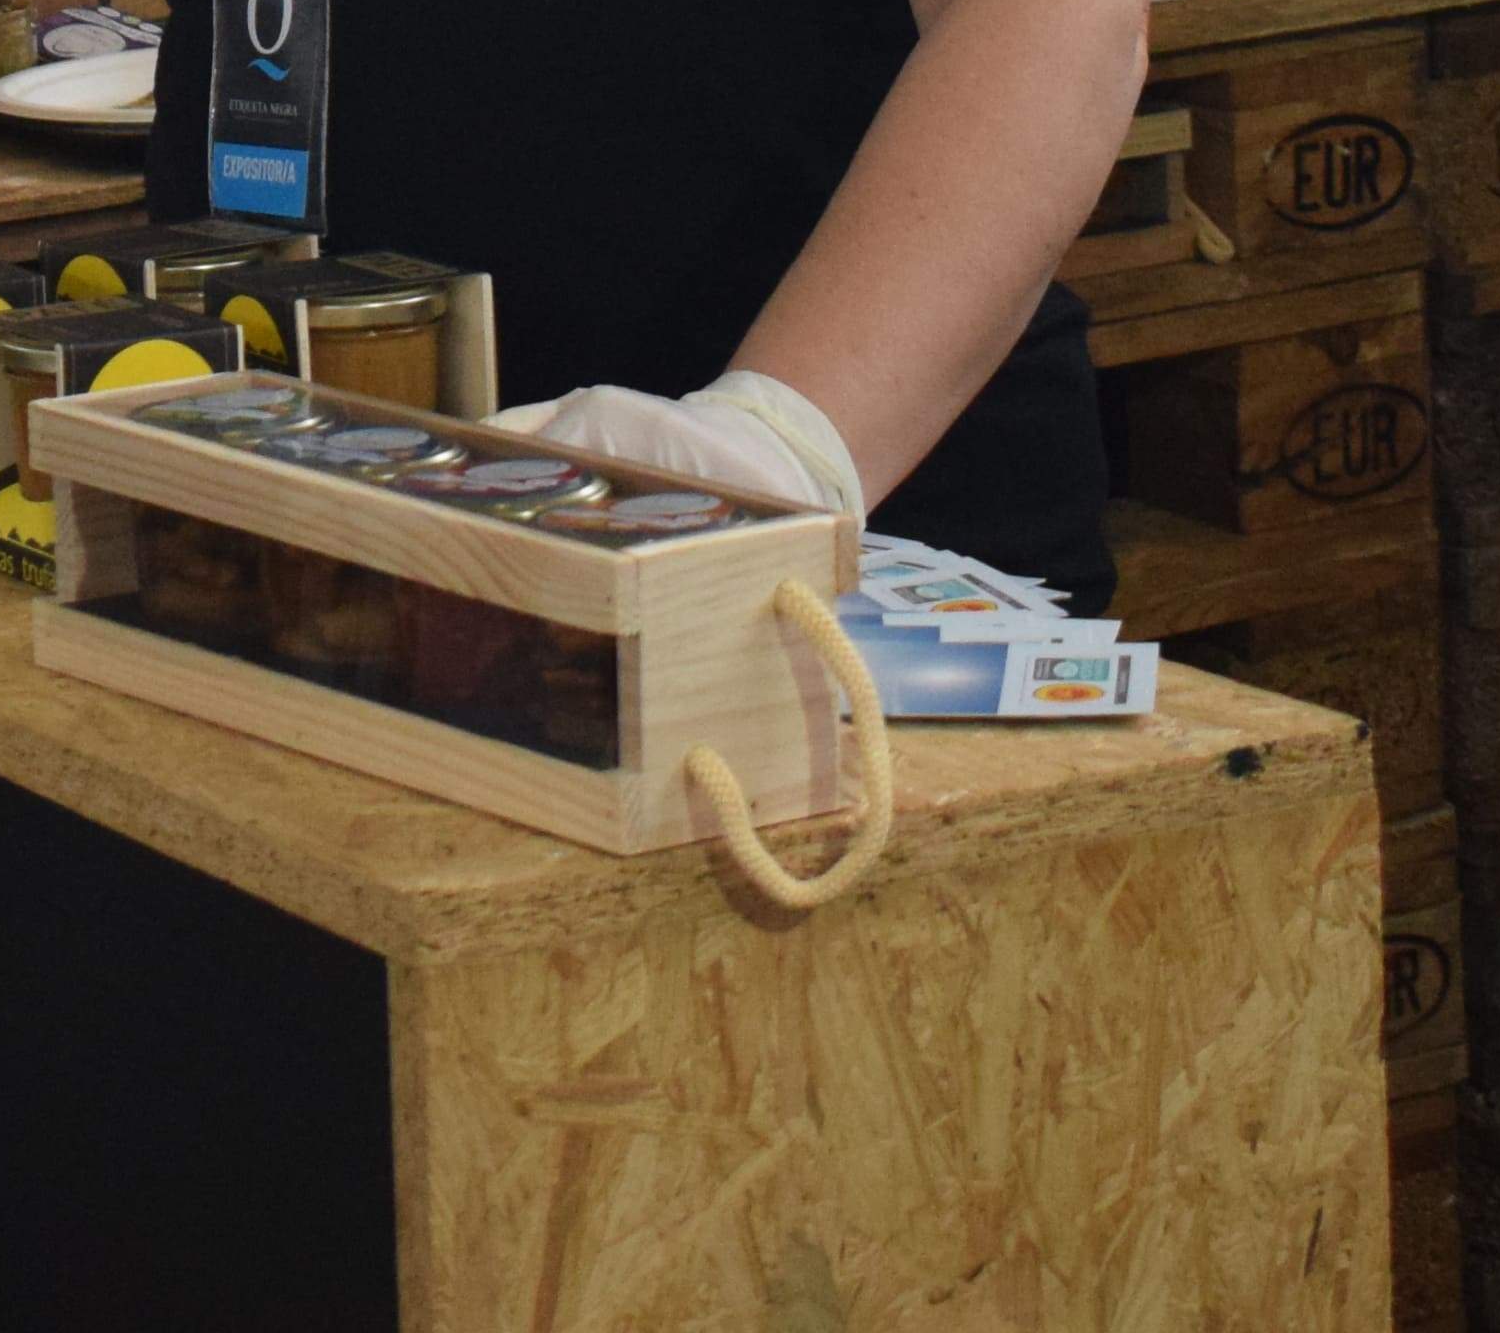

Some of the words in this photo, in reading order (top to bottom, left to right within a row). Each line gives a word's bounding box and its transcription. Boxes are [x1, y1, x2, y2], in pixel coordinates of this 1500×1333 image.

[223, 154, 297, 184] EXPOSITOR/A
[1292, 134, 1382, 213] EUR
[1313, 404, 1400, 484] EUR
